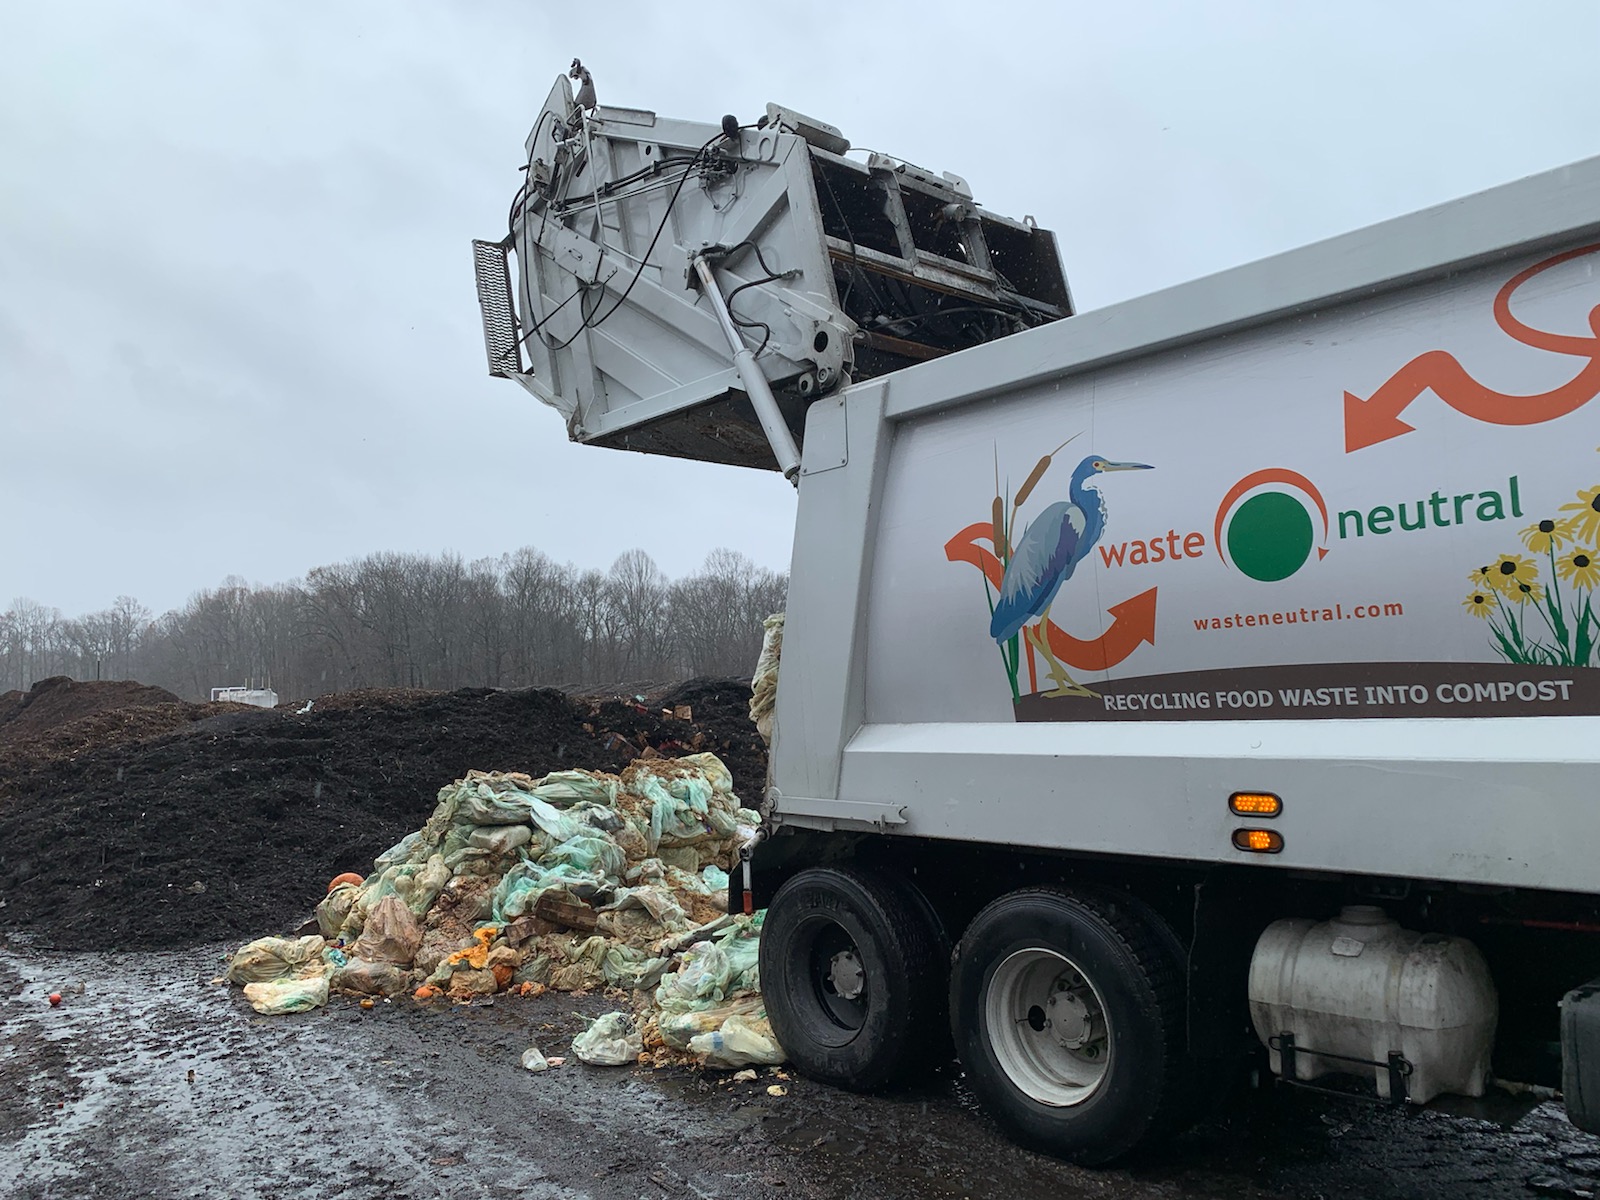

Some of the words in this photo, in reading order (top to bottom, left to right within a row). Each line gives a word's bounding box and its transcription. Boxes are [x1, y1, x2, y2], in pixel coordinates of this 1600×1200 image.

[1099, 529, 1206, 568] waste
[1338, 475, 1524, 539] neutral
[1194, 602, 1404, 630] wasteneutral.com
[1103, 692, 1211, 711] RECYCLING
[1216, 689, 1274, 709] FOOD
[1278, 686, 1359, 707] WASTE
[1364, 684, 1429, 705] INTO
[1435, 679, 1574, 703] COMPOST
